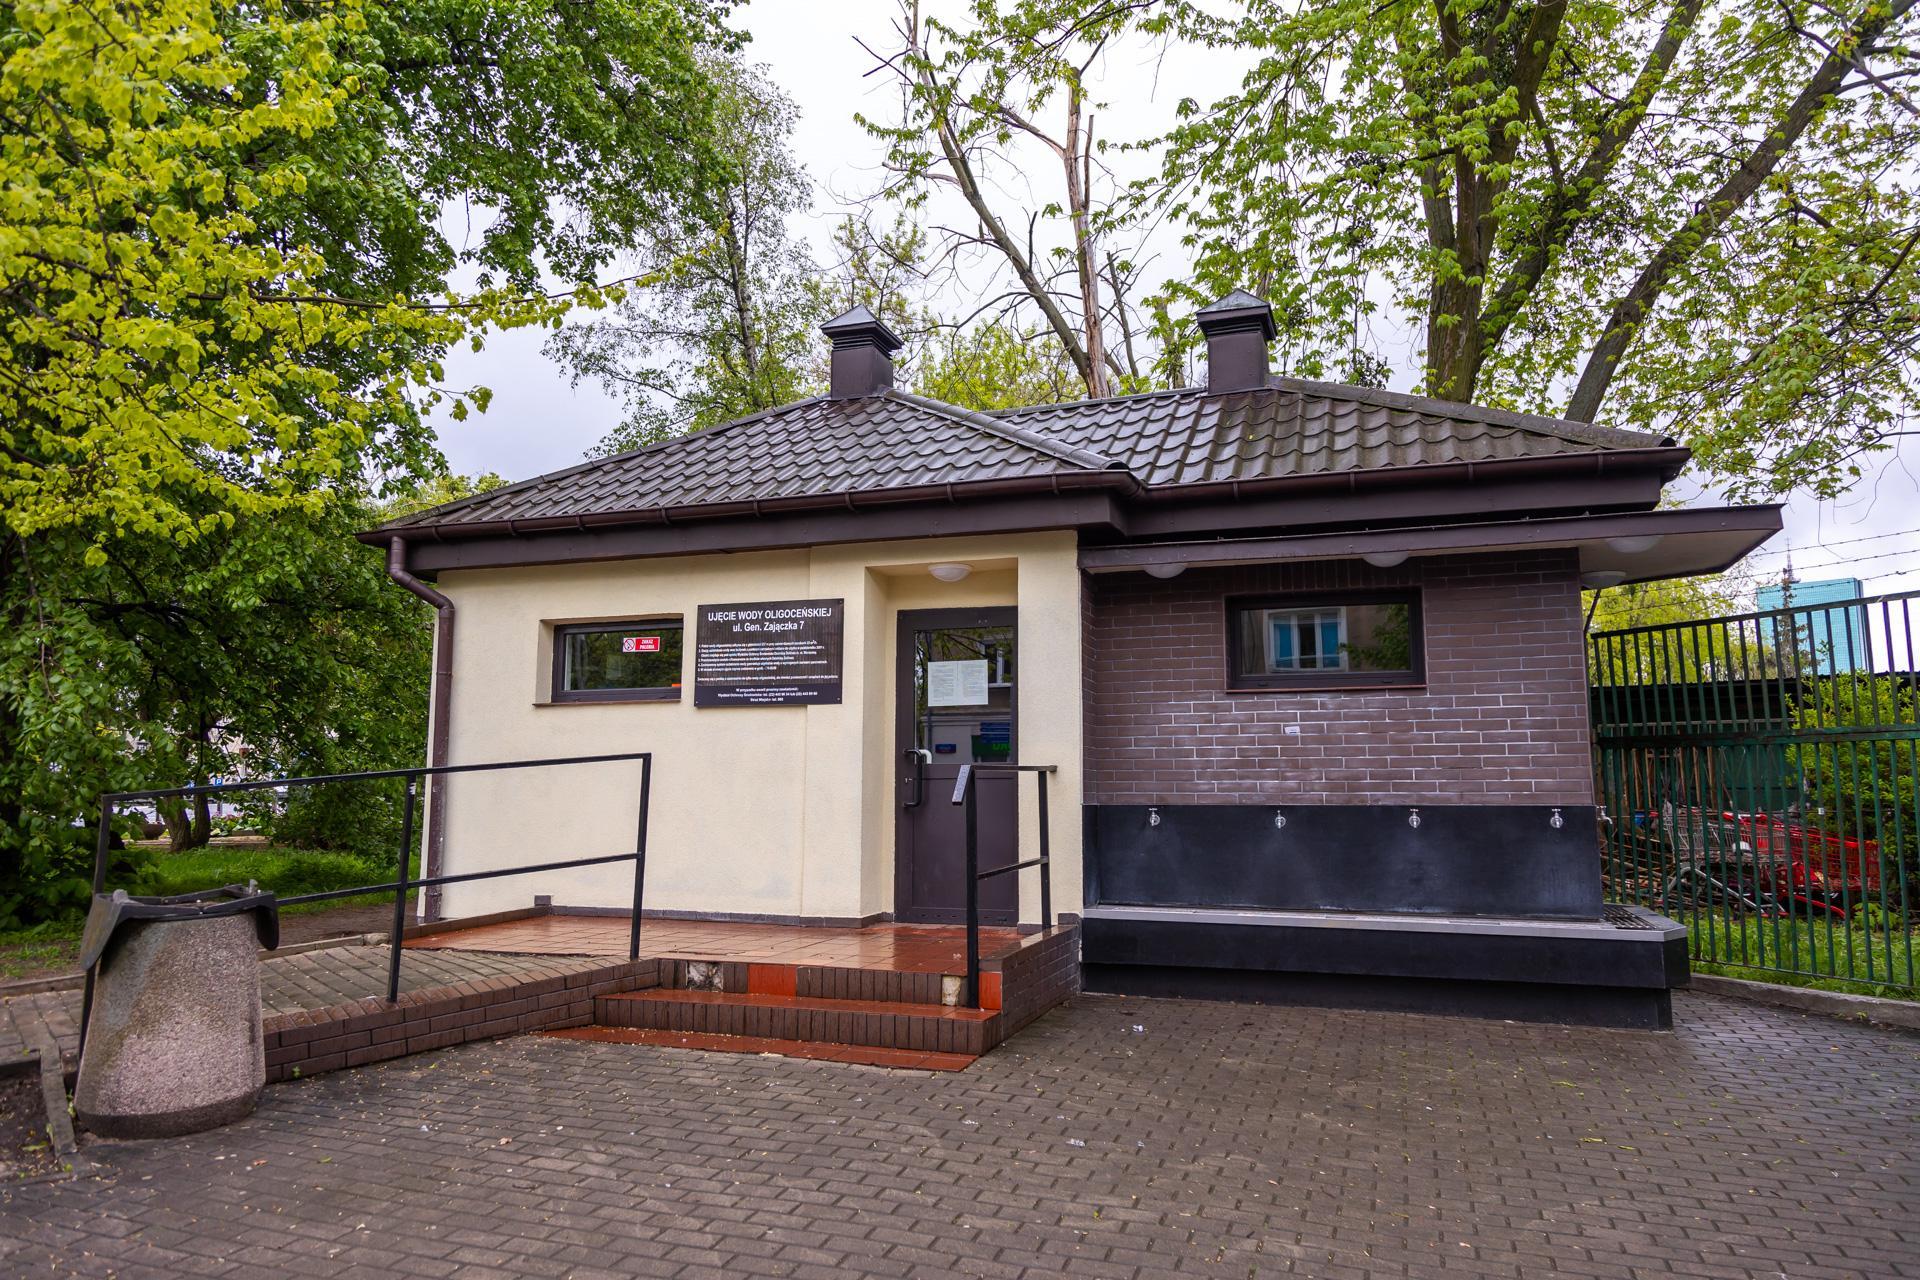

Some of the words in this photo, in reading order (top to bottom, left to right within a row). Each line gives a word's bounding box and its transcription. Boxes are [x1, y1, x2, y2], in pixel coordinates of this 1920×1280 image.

[708, 611, 736, 622] UJĘCIE
[738, 610, 763, 620] WODY
[764, 606, 832, 619] OLIGOCEŃSKIEJ
[732, 623, 742, 632] ul.
[744, 622, 762, 631] Gen.
[763, 621, 798, 633] Zajączka
[799, 620, 805, 630] 7
